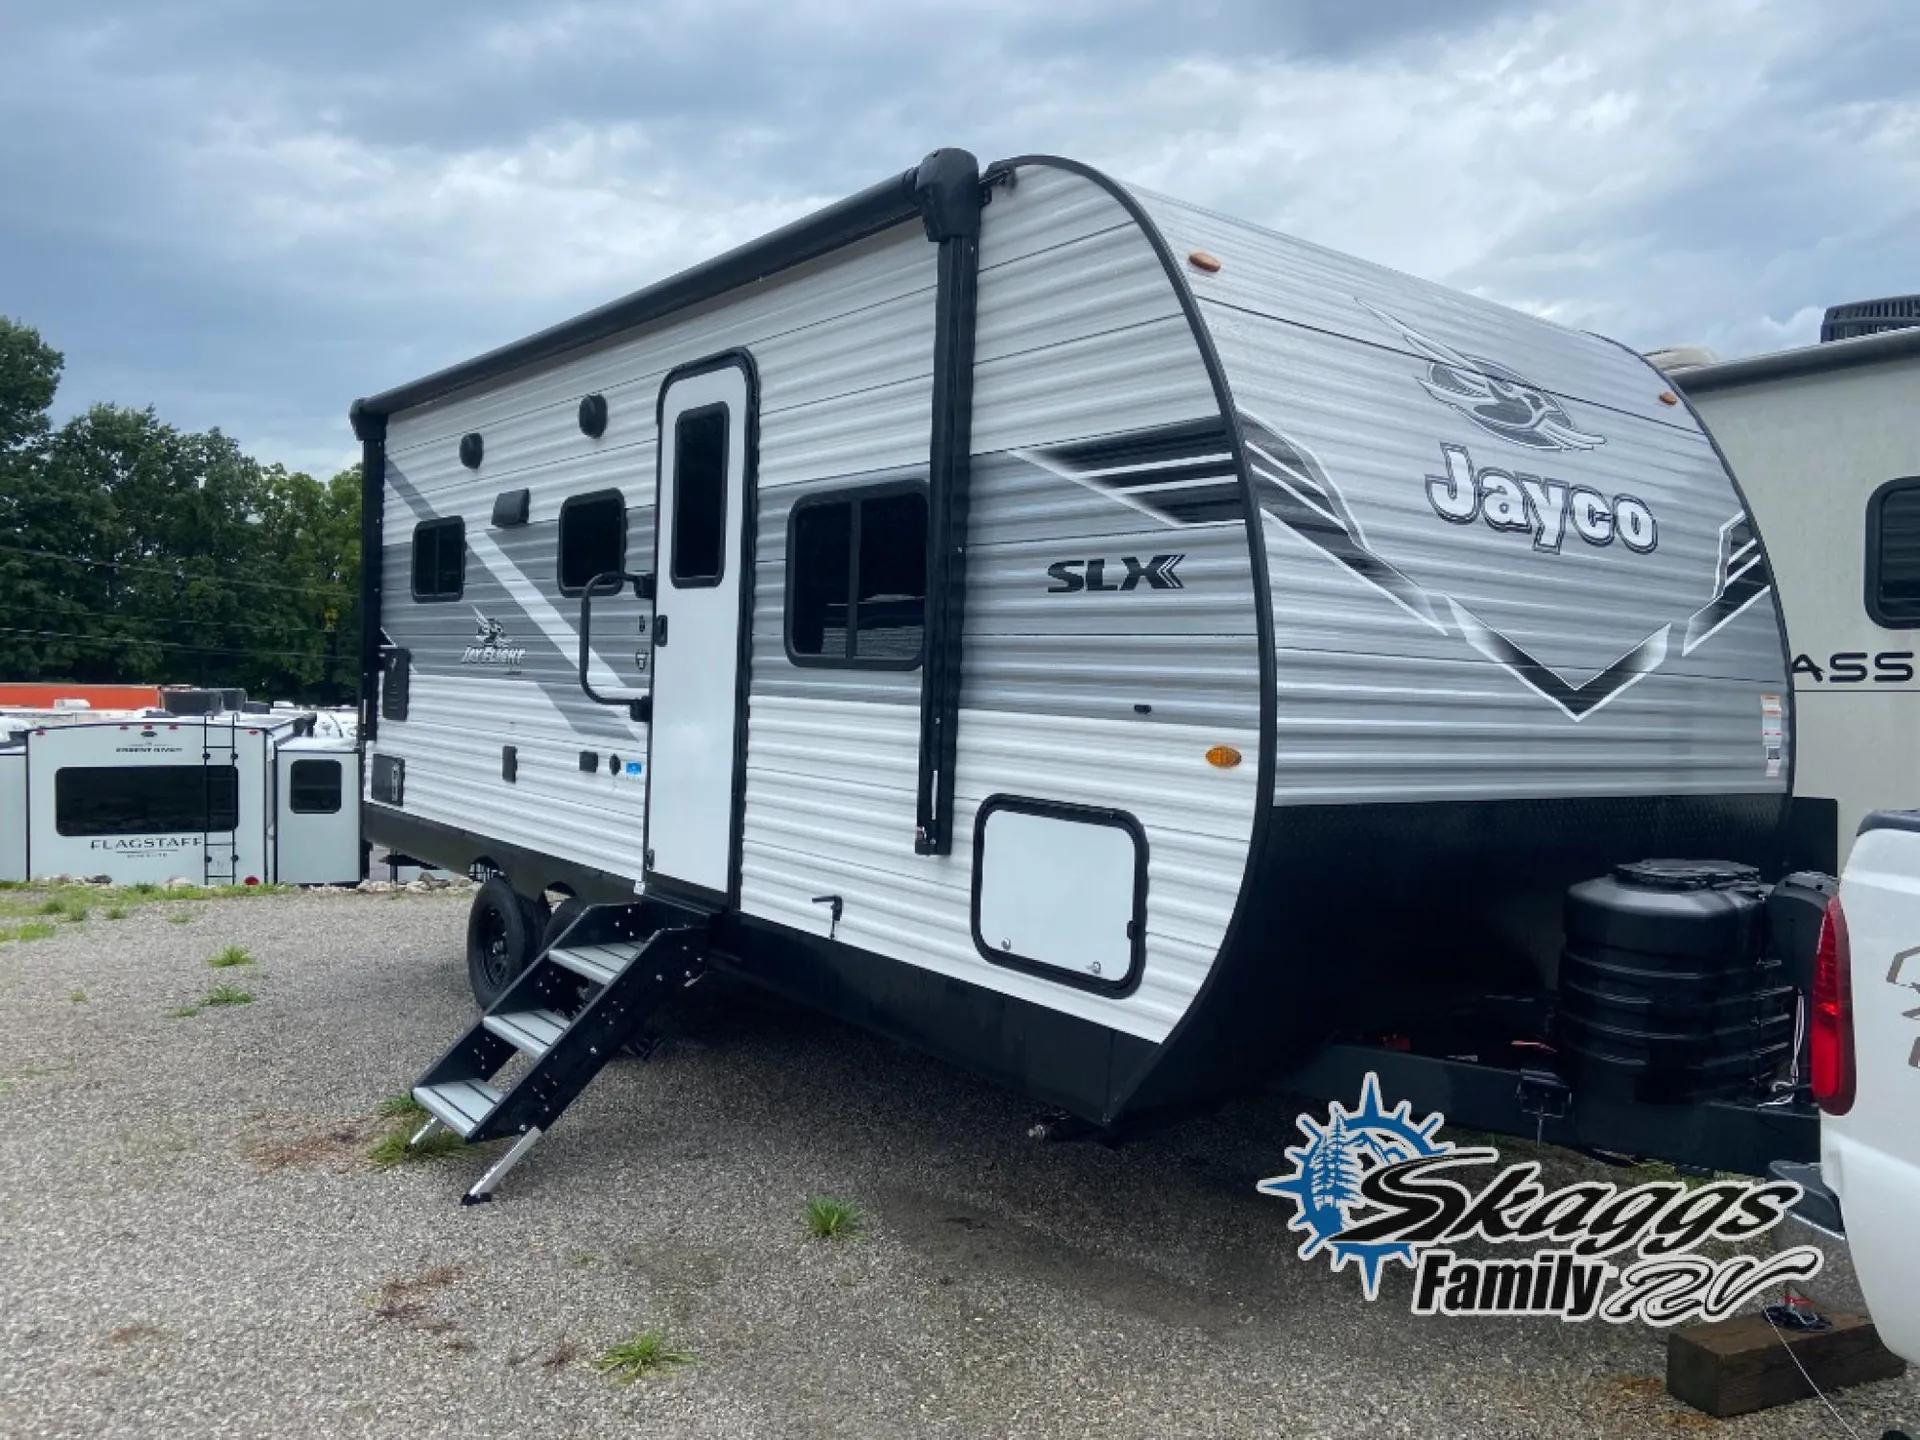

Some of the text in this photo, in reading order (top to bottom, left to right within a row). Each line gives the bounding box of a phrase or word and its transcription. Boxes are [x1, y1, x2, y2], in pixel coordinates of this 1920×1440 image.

[1424, 442, 1658, 555] Jayco
[1047, 554, 1186, 593] SLX
[1792, 652, 1914, 682] ASS
[90, 837, 202, 850] FLAGSTAFF
